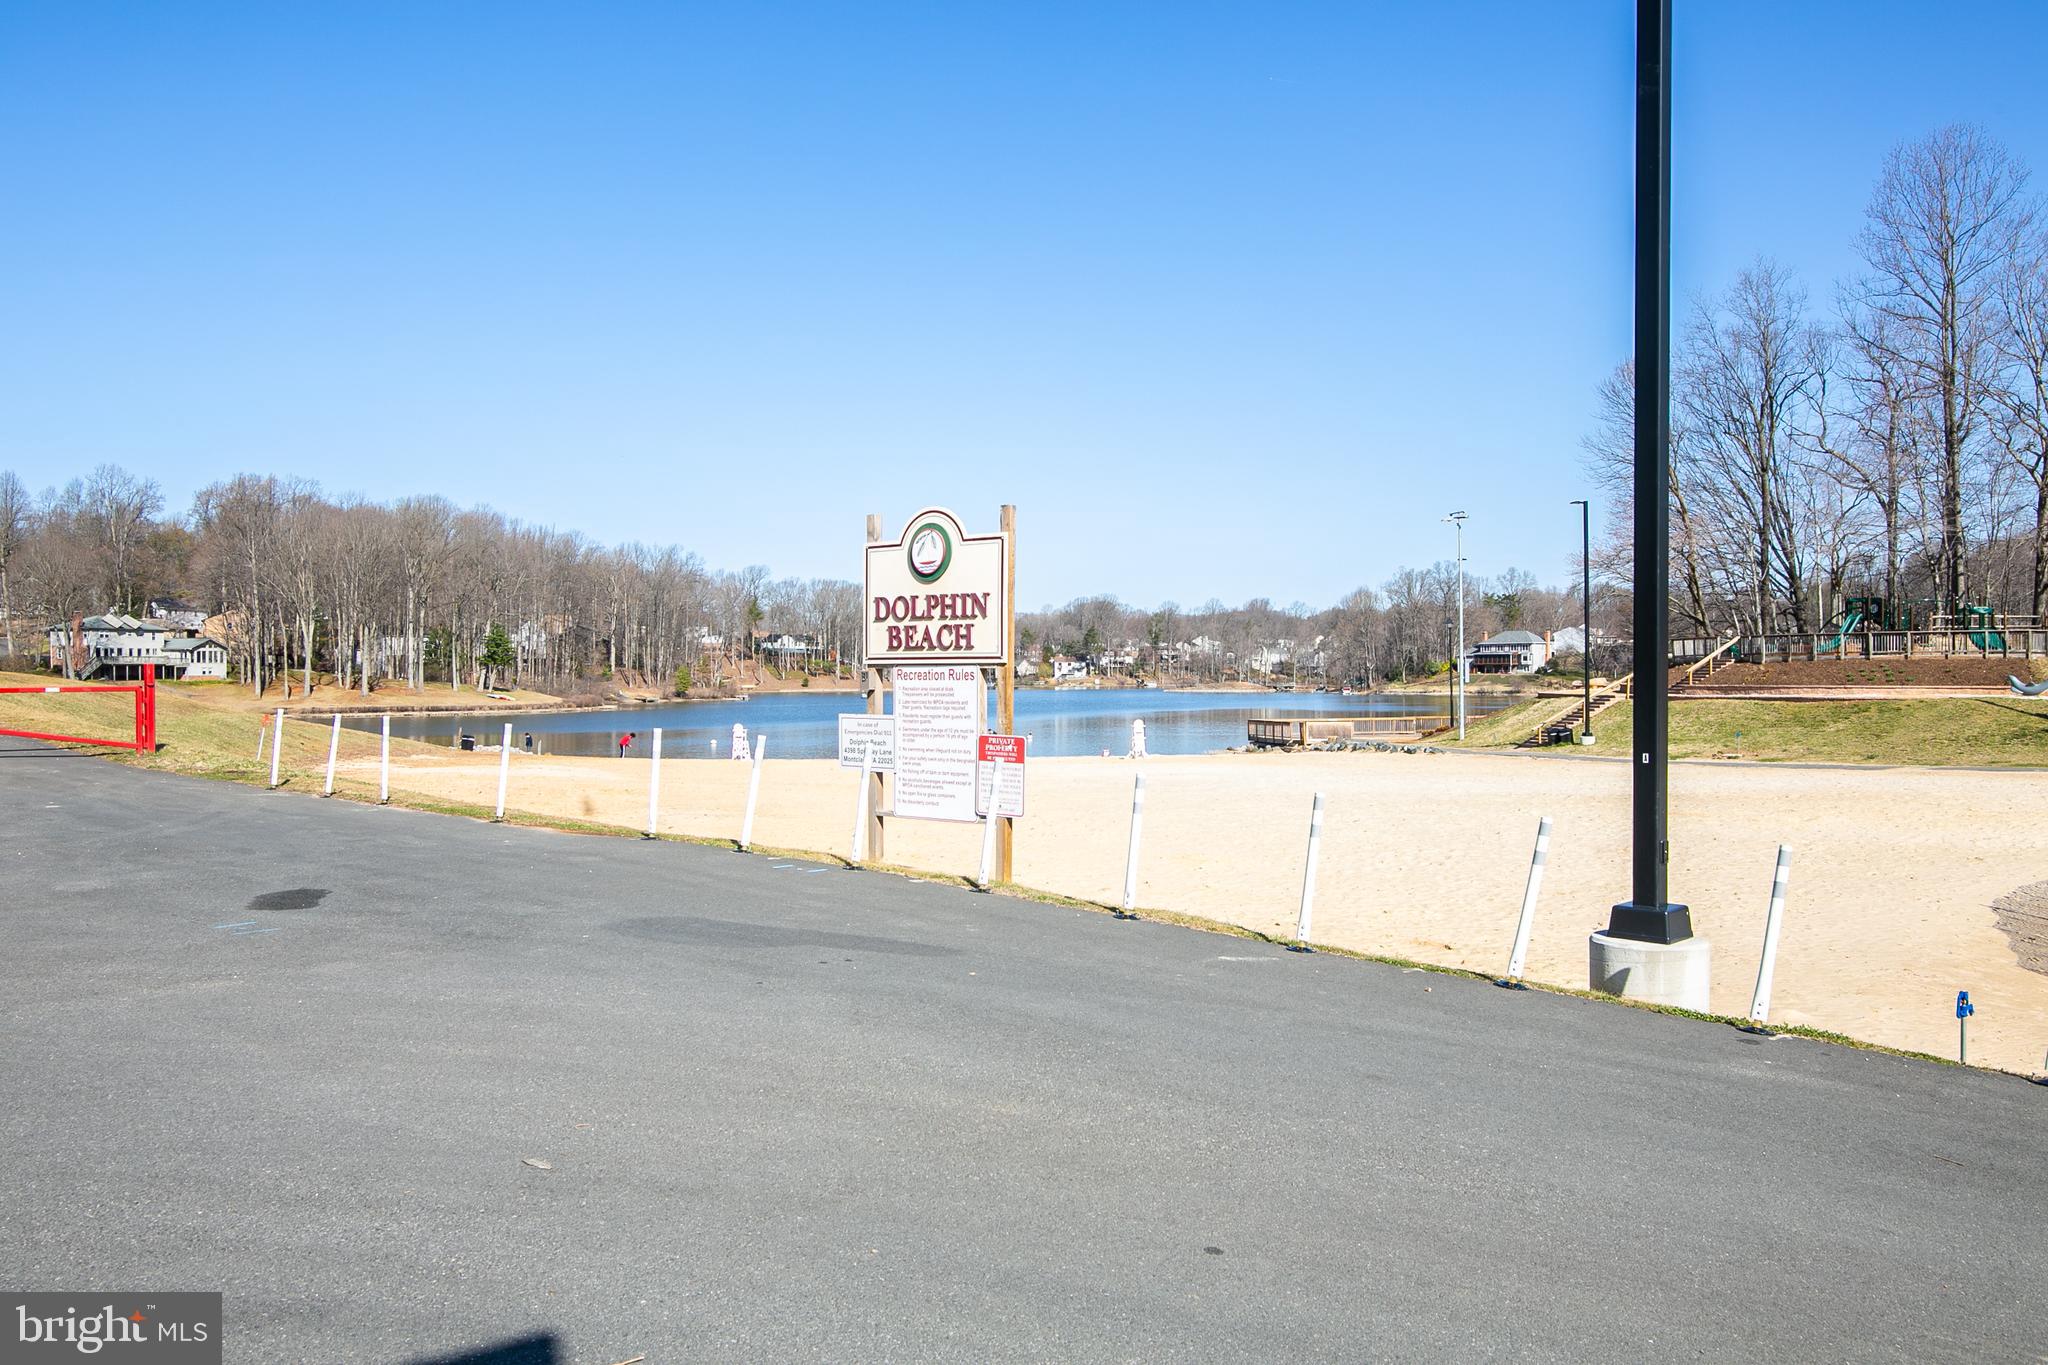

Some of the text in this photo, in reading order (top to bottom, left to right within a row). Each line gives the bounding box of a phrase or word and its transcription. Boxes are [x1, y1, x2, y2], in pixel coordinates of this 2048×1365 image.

[873, 592, 990, 623] DOLPHIN
[886, 624, 975, 652] BEACH
[897, 668, 975, 681] Recreation Rules
[988, 737, 1015, 745] PRIVATE
